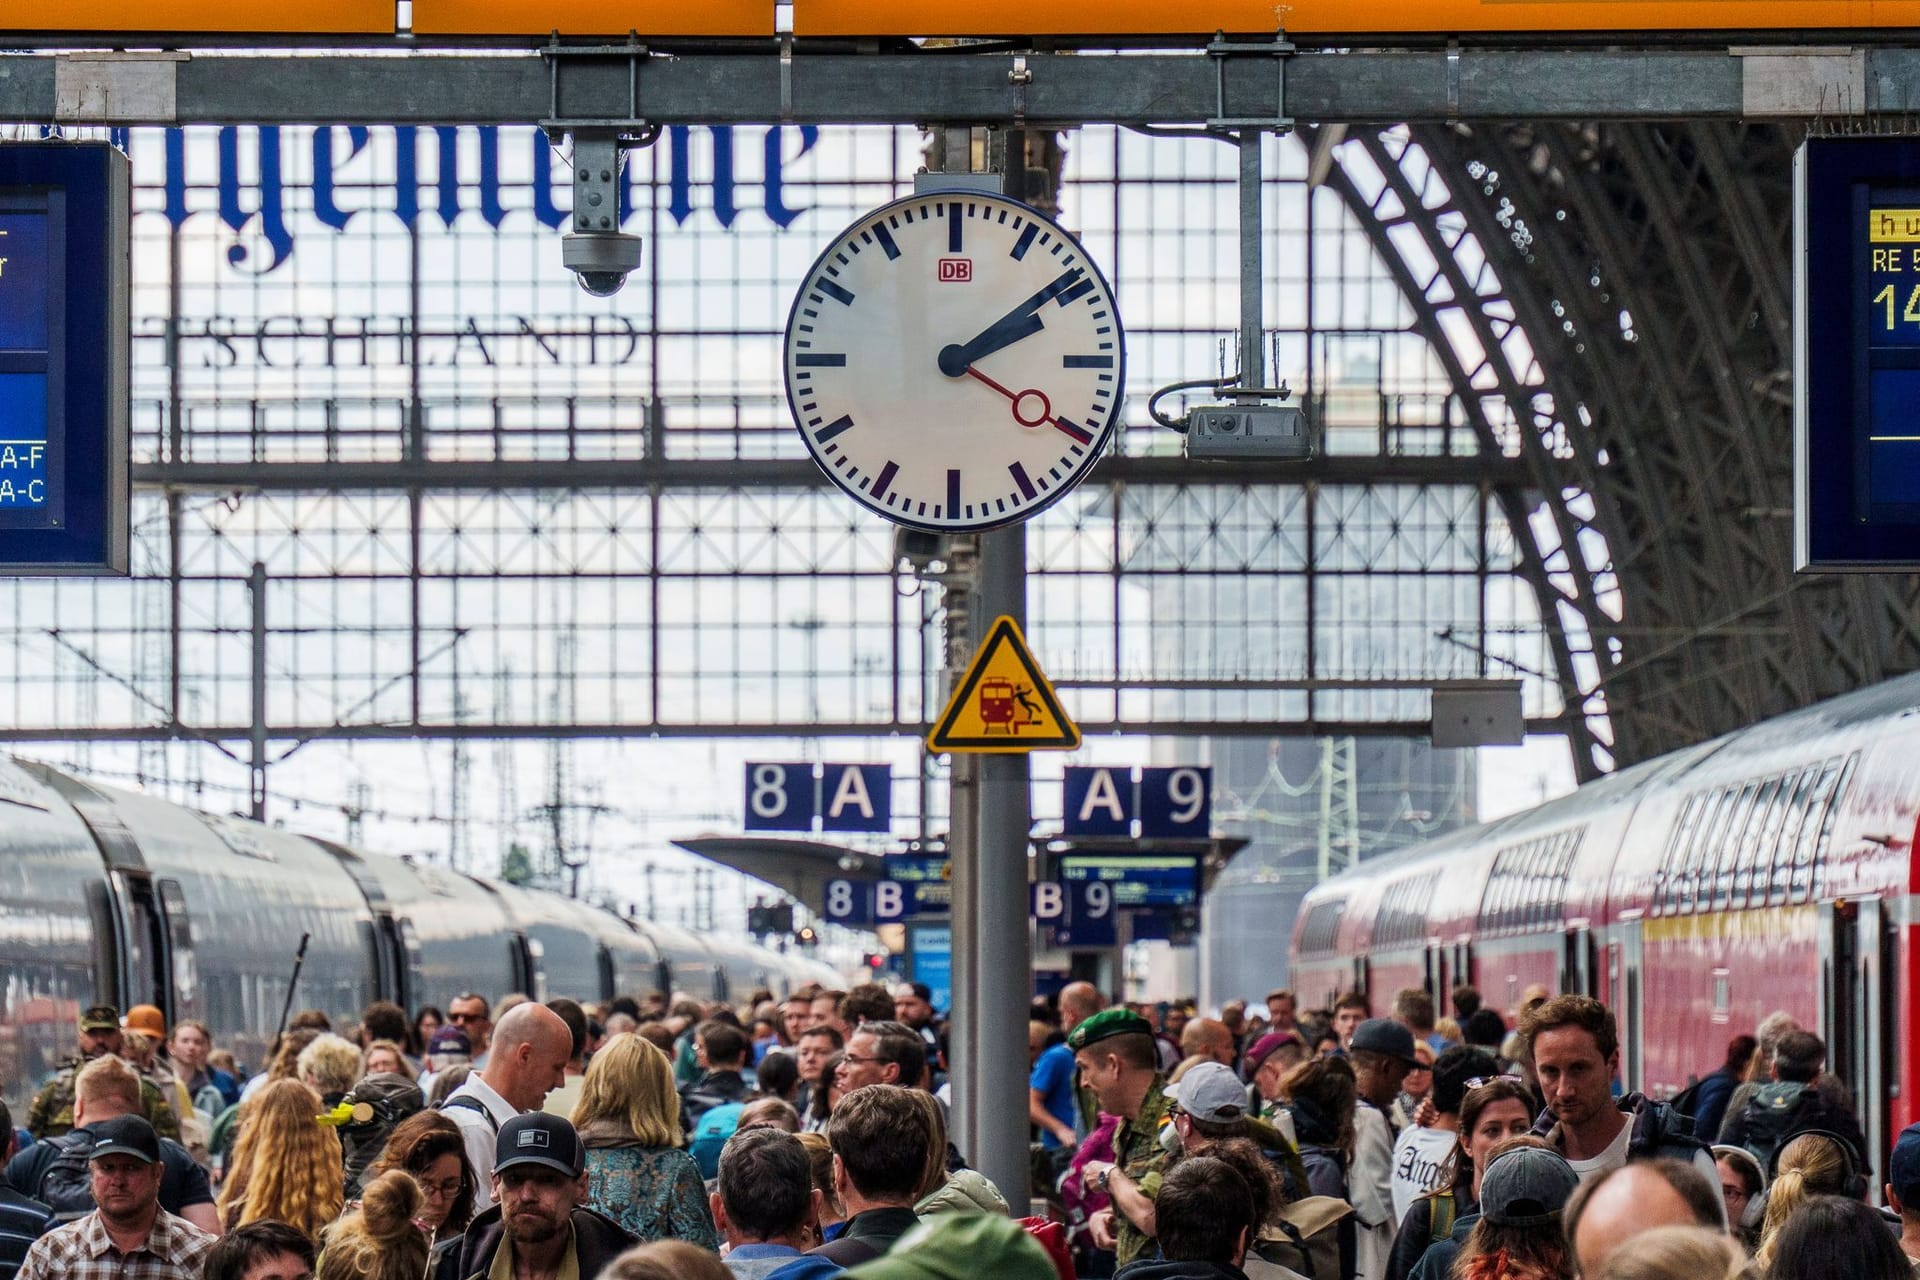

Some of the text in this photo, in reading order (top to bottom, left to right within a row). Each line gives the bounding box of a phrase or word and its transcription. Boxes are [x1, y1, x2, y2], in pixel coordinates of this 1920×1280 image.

[942, 262, 968, 279] DB
[1873, 249, 1902, 272] RE
[0, 445, 44, 469] A-F
[0, 479, 44, 502] A-C
[751, 764, 875, 818] 8 A
[1078, 768, 1204, 823] A 9
[828, 879, 853, 918] 8
[876, 881, 903, 918] B
[1035, 881, 1063, 918] B
[1085, 881, 1111, 919] 9
